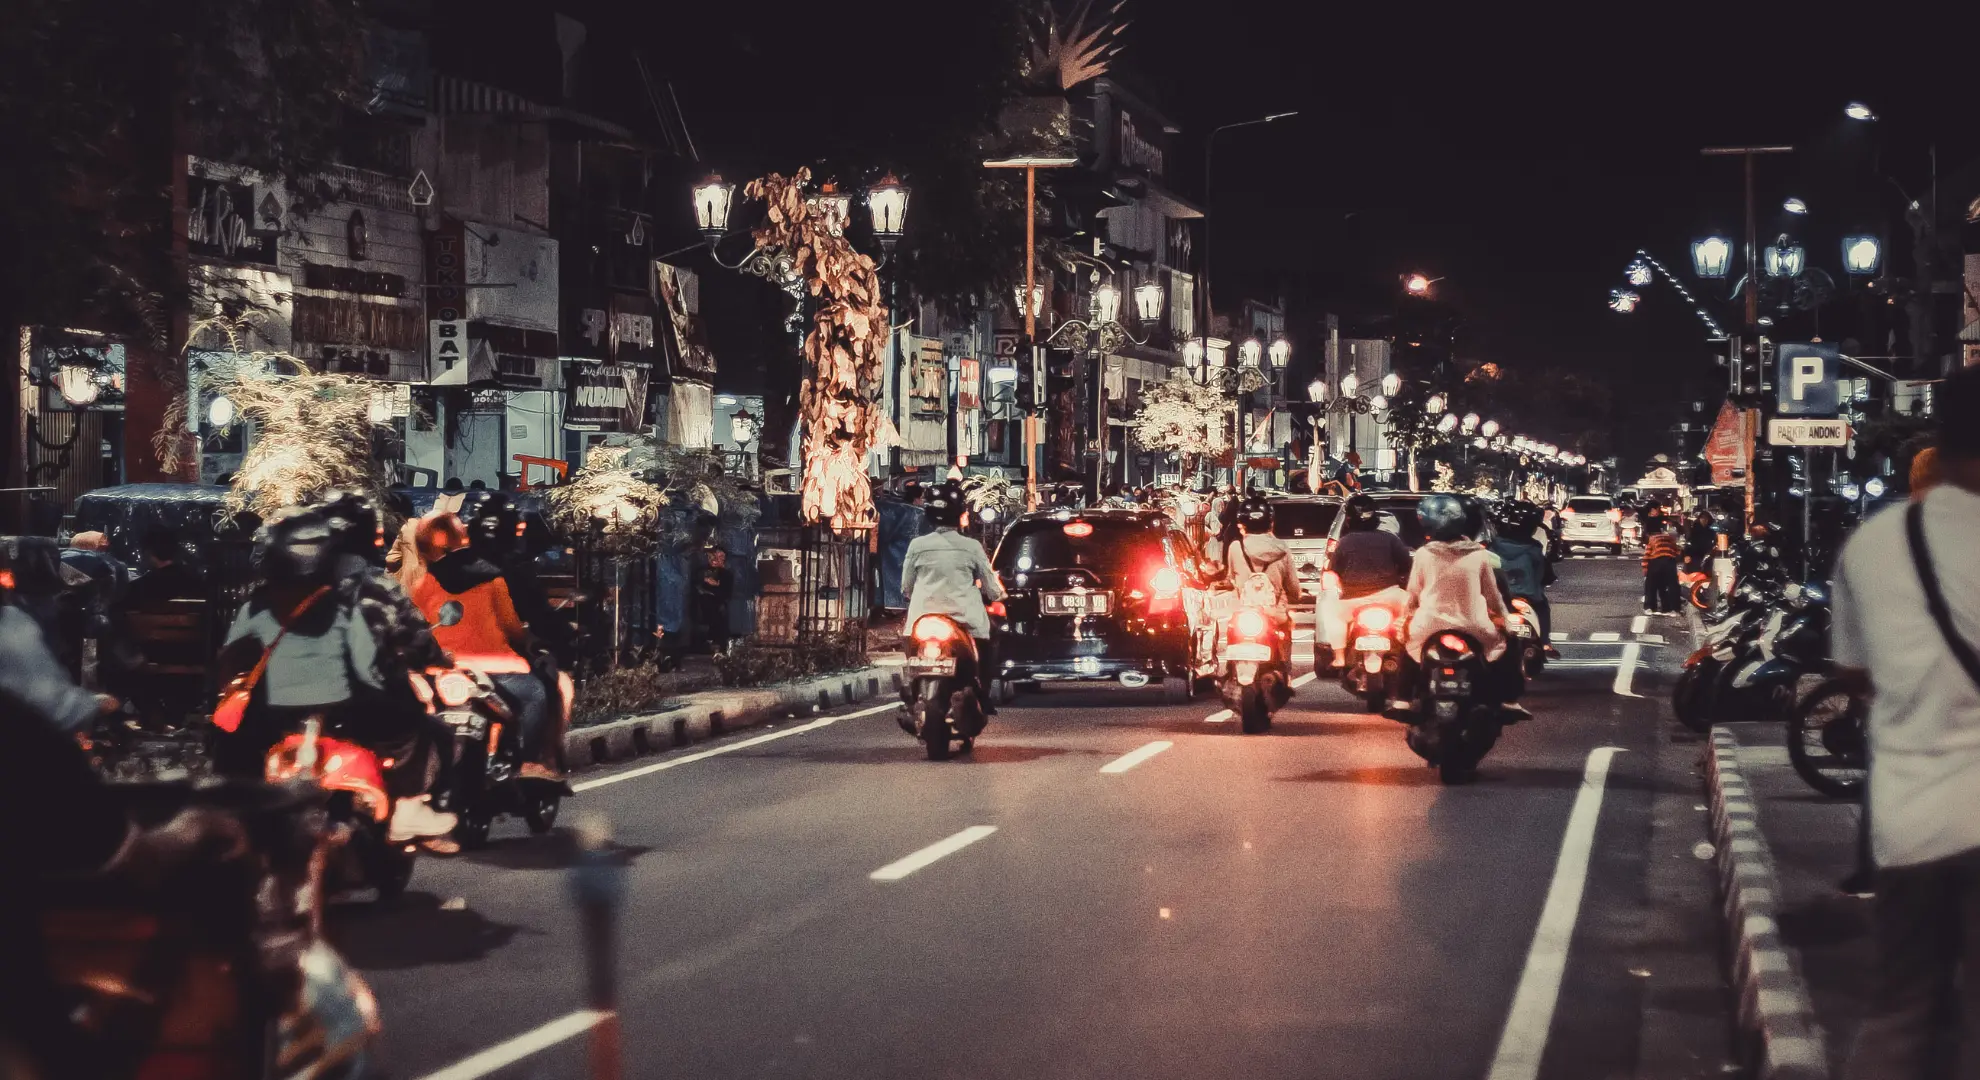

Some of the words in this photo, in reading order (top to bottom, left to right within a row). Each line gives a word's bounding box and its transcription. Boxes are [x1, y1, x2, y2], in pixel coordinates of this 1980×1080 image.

[435, 236, 458, 300] TOKO
[438, 307, 460, 370] OBAT
[1792, 357, 1824, 400] P
[1777, 425, 1806, 439] PARKIR
[1808, 426, 1841, 439] ANDONG
